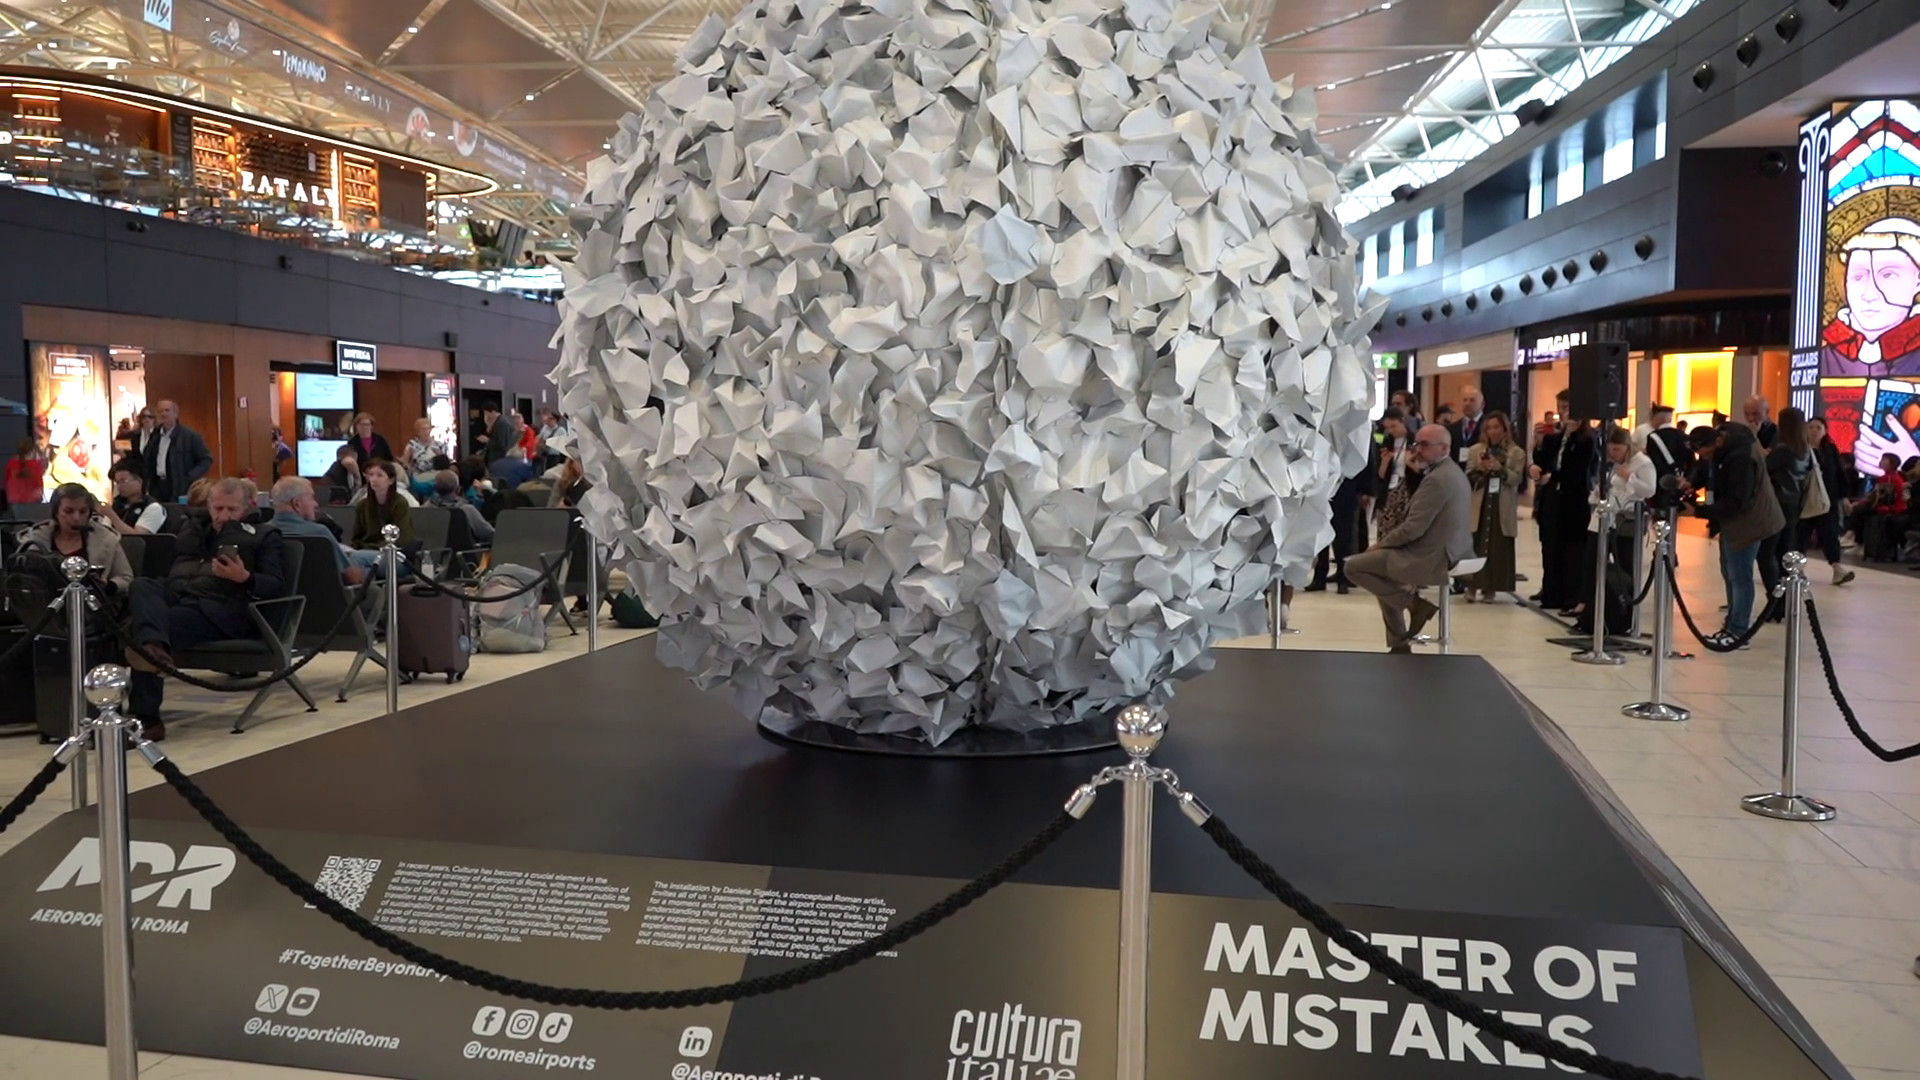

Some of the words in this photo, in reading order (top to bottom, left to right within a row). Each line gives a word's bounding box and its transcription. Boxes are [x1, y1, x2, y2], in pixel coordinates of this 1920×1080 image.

[241, 171, 338, 208] EATALY
[1790, 370, 1802, 387] OF
[1801, 368, 1818, 386] ART
[1791, 351, 1819, 368] PILLARS
[36, 837, 236, 911] ADR
[30, 908, 103, 927] AEROPOR
[140, 918, 190, 934] ROMA
[278, 948, 468, 985] #TogetherBeyond
[1203, 922, 1514, 995] MASTER
[1532, 945, 1639, 1003] OF
[243, 1017, 400, 1050] @AeroportidiRoma
[949, 1002, 1083, 1066] cultura
[1199, 987, 1599, 1075] MISTAKES
[463, 1040, 597, 1070] @romeairports
